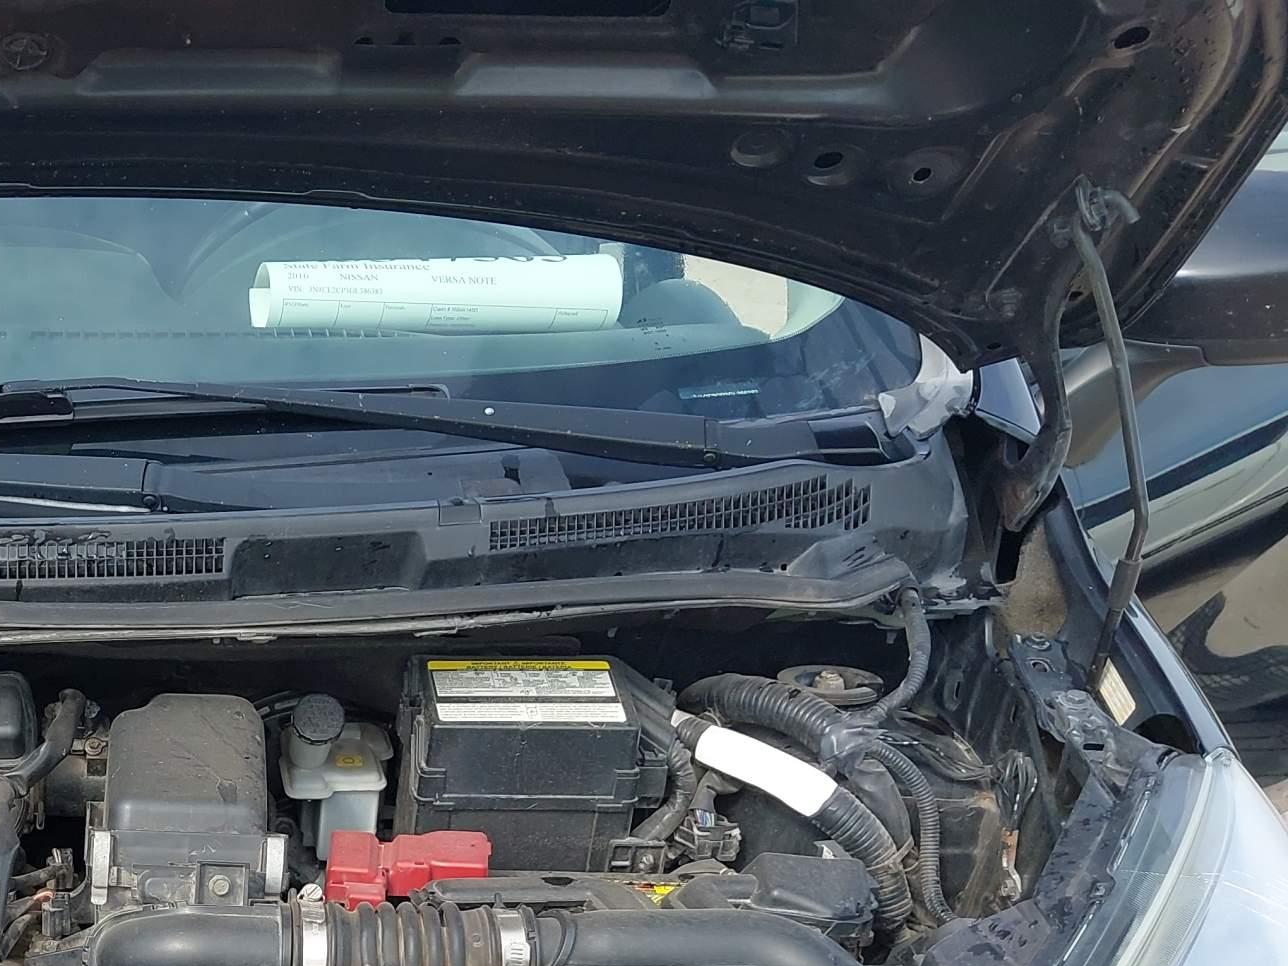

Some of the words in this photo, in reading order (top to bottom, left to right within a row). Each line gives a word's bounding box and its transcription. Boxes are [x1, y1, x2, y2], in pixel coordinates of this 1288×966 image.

[283, 262, 318, 270] State
[322, 262, 360, 270] Farm
[363, 262, 431, 271] Insurance
[339, 272, 379, 281] NISSAN
[431, 274, 466, 285] VERSA
[468, 275, 497, 286] NOTE
